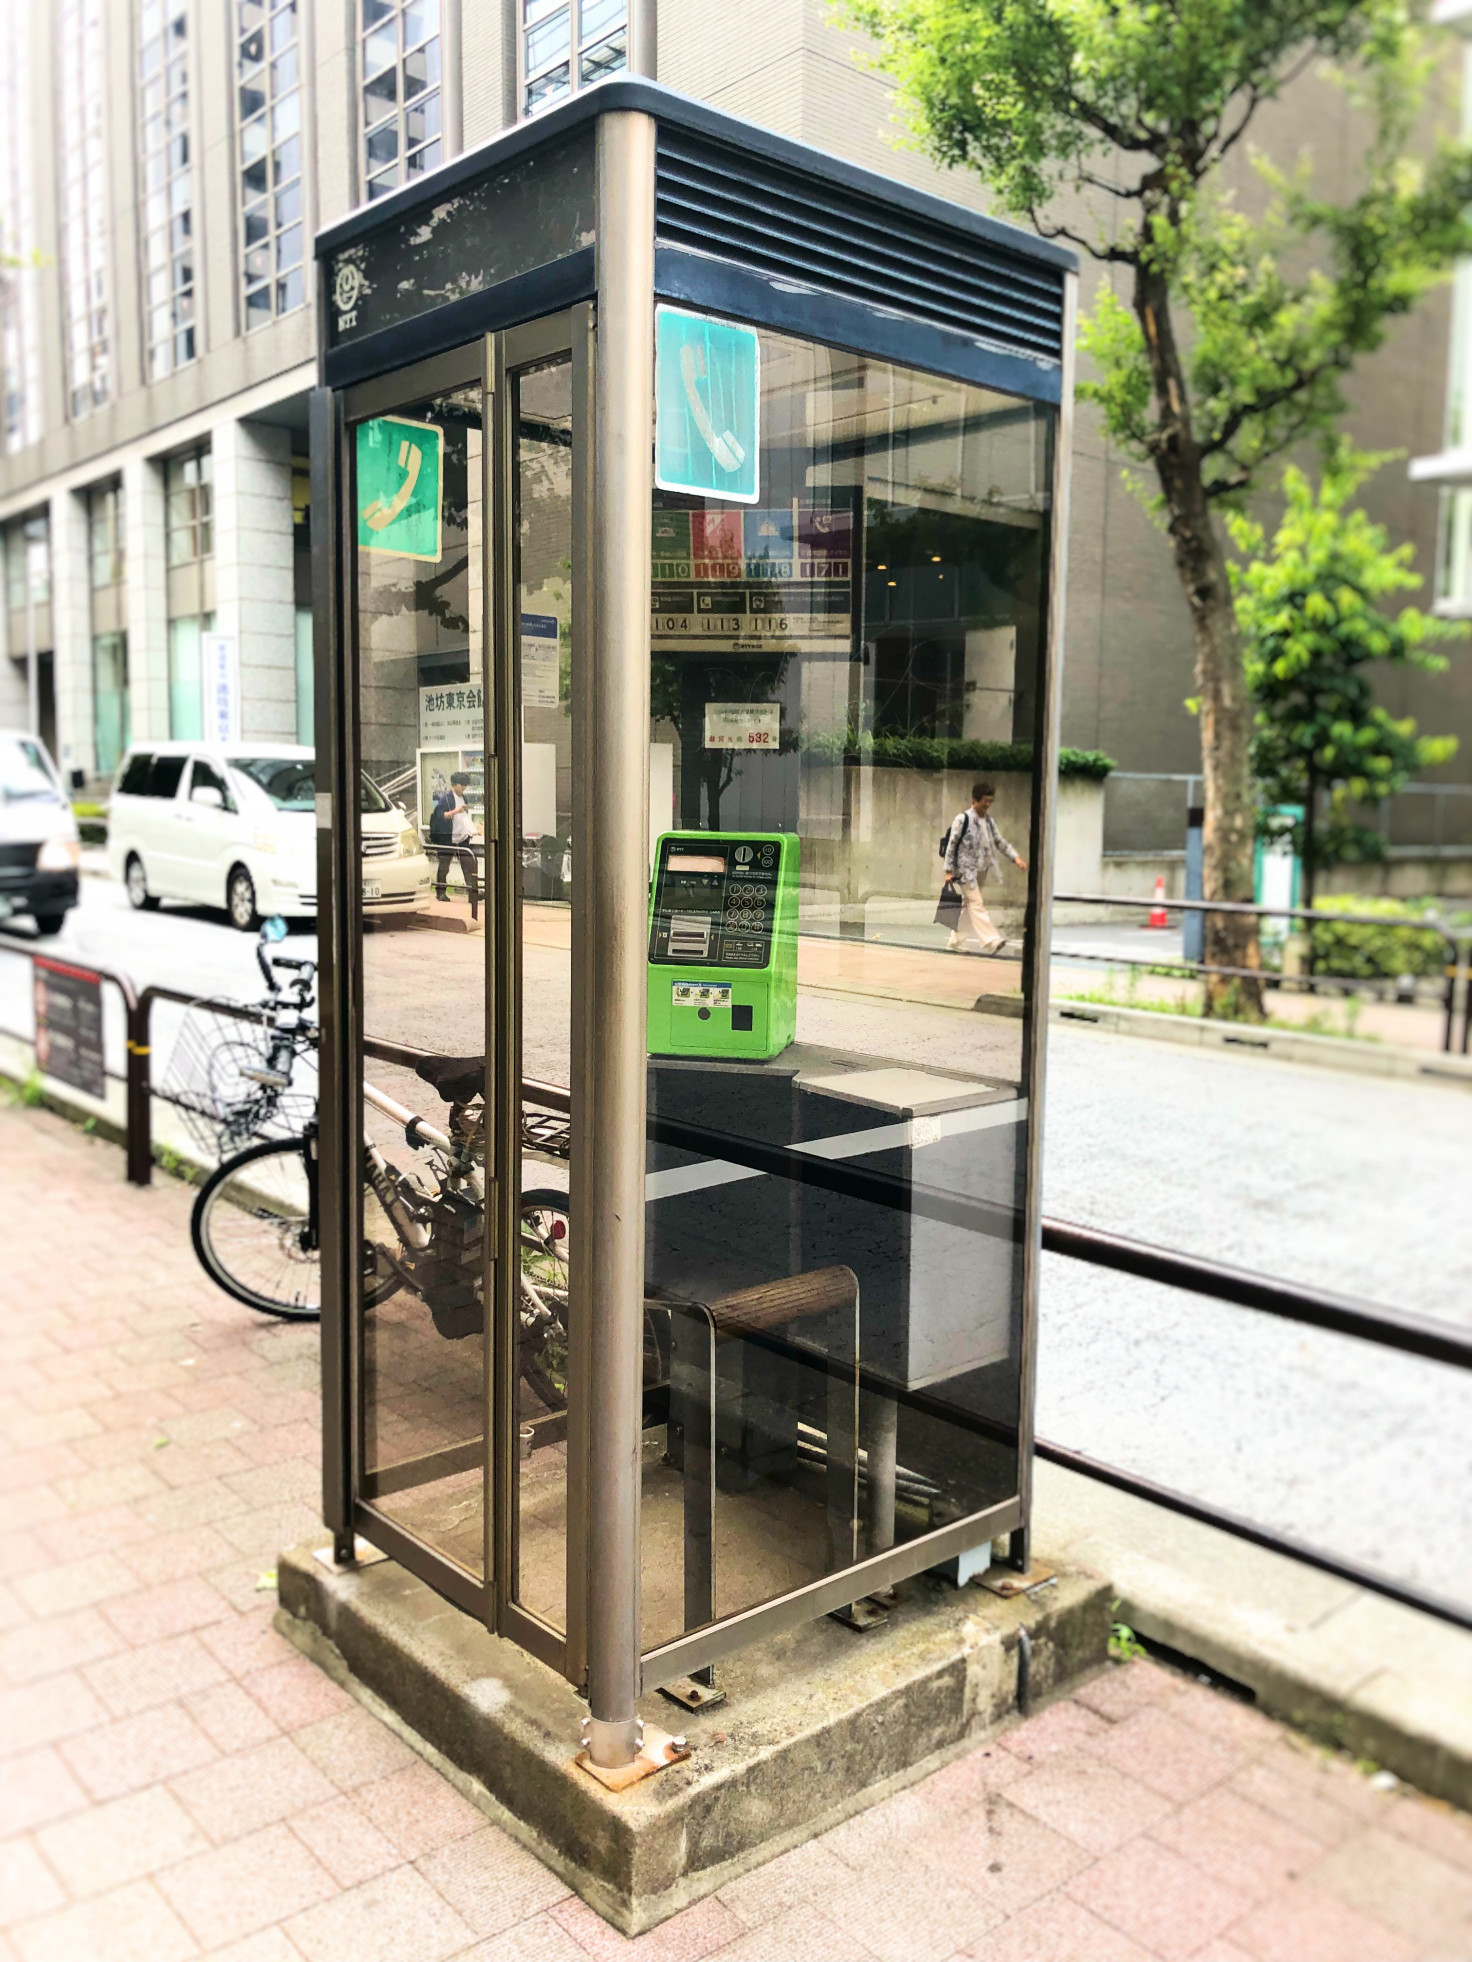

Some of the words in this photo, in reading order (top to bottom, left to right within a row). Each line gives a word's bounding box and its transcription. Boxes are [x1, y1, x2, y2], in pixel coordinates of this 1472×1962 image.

[338, 310, 357, 332] NTT
[700, 563, 739, 577] 119
[806, 563, 843, 577] 171
[655, 617, 688, 631] 104
[707, 617, 740, 631] 113
[754, 617, 788, 631] 116
[748, 732, 769, 744] 532
